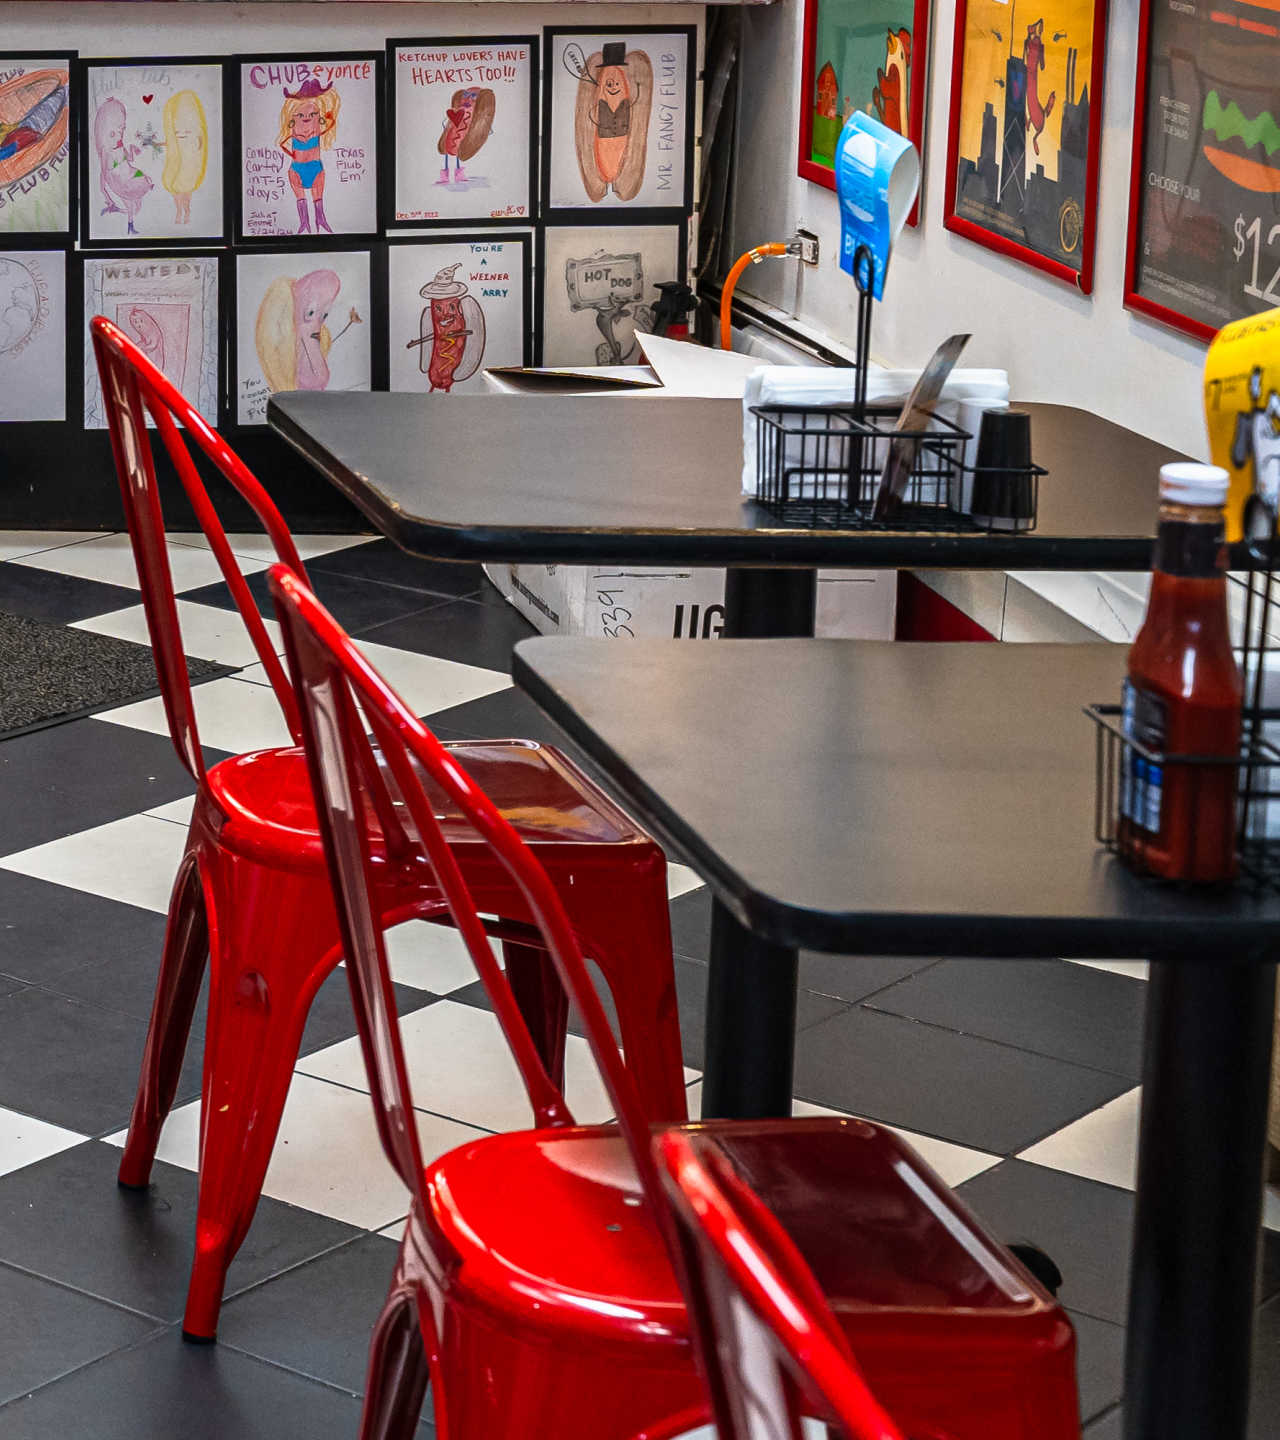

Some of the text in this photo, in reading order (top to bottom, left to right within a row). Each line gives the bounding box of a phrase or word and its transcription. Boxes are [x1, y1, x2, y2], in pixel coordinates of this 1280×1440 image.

[398, 49, 528, 64] KETCHUP LOVERS HAVE
[412, 66, 474, 87] HEARTS
[660, 53, 677, 97] FLUB
[658, 102, 680, 152] FANCY
[480, 258, 487, 266] A
[469, 272, 510, 283] WEINER
[584, 271, 632, 288] HOT DOG
